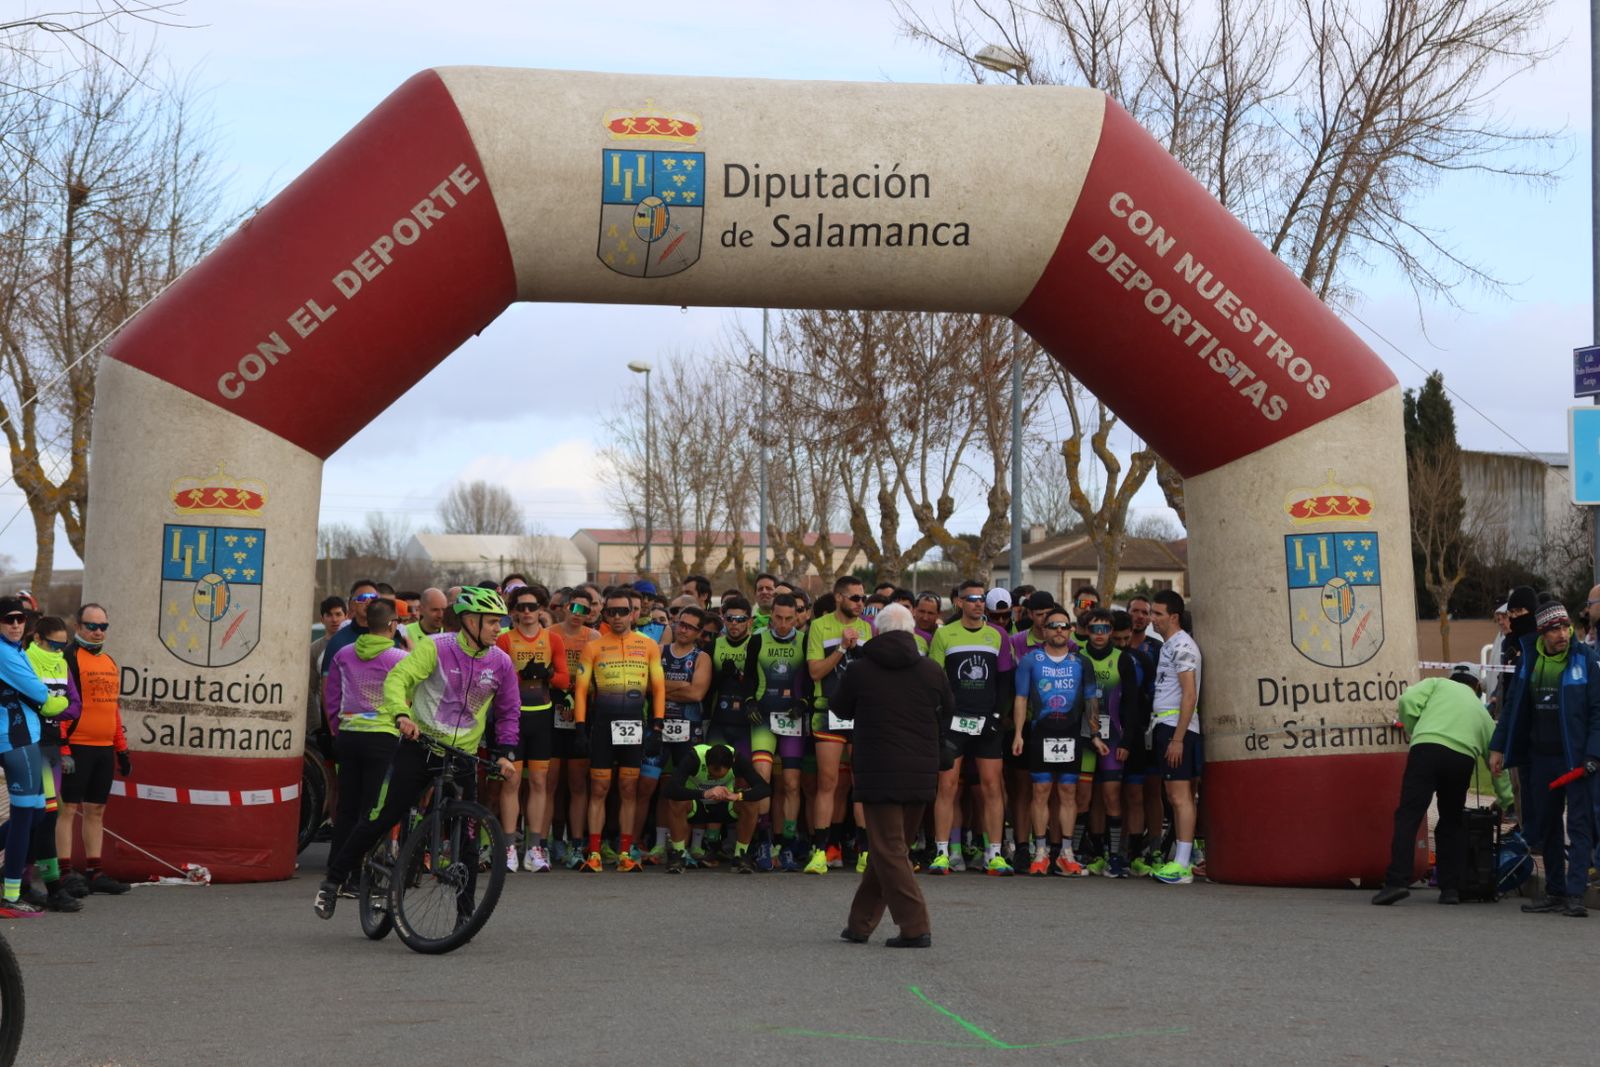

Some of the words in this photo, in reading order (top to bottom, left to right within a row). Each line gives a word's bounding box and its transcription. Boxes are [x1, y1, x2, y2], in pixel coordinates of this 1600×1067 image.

[724, 163, 930, 207] Diputación
[720, 222, 753, 248] de
[770, 213, 970, 248] Salamanca
[217, 331, 292, 400] CON
[287, 299, 337, 339] EL
[332, 163, 480, 299] DEPORTE
[1109, 191, 1177, 258] CON
[1173, 252, 1331, 400] NUESTROS
[1087, 234, 1289, 421] DEPORTISTAS
[768, 648, 795, 658] MATEO
[119, 666, 283, 706] Diputación
[1055, 679, 1074, 689] MSC
[1257, 672, 1408, 712] Diputación
[140, 714, 292, 750] Salamanca
[619, 726, 636, 737] 32
[666, 725, 682, 735] 38
[777, 719, 796, 729] 94
[959, 718, 978, 731] 95
[1051, 744, 1068, 755] 44
[1245, 727, 1270, 751] de
